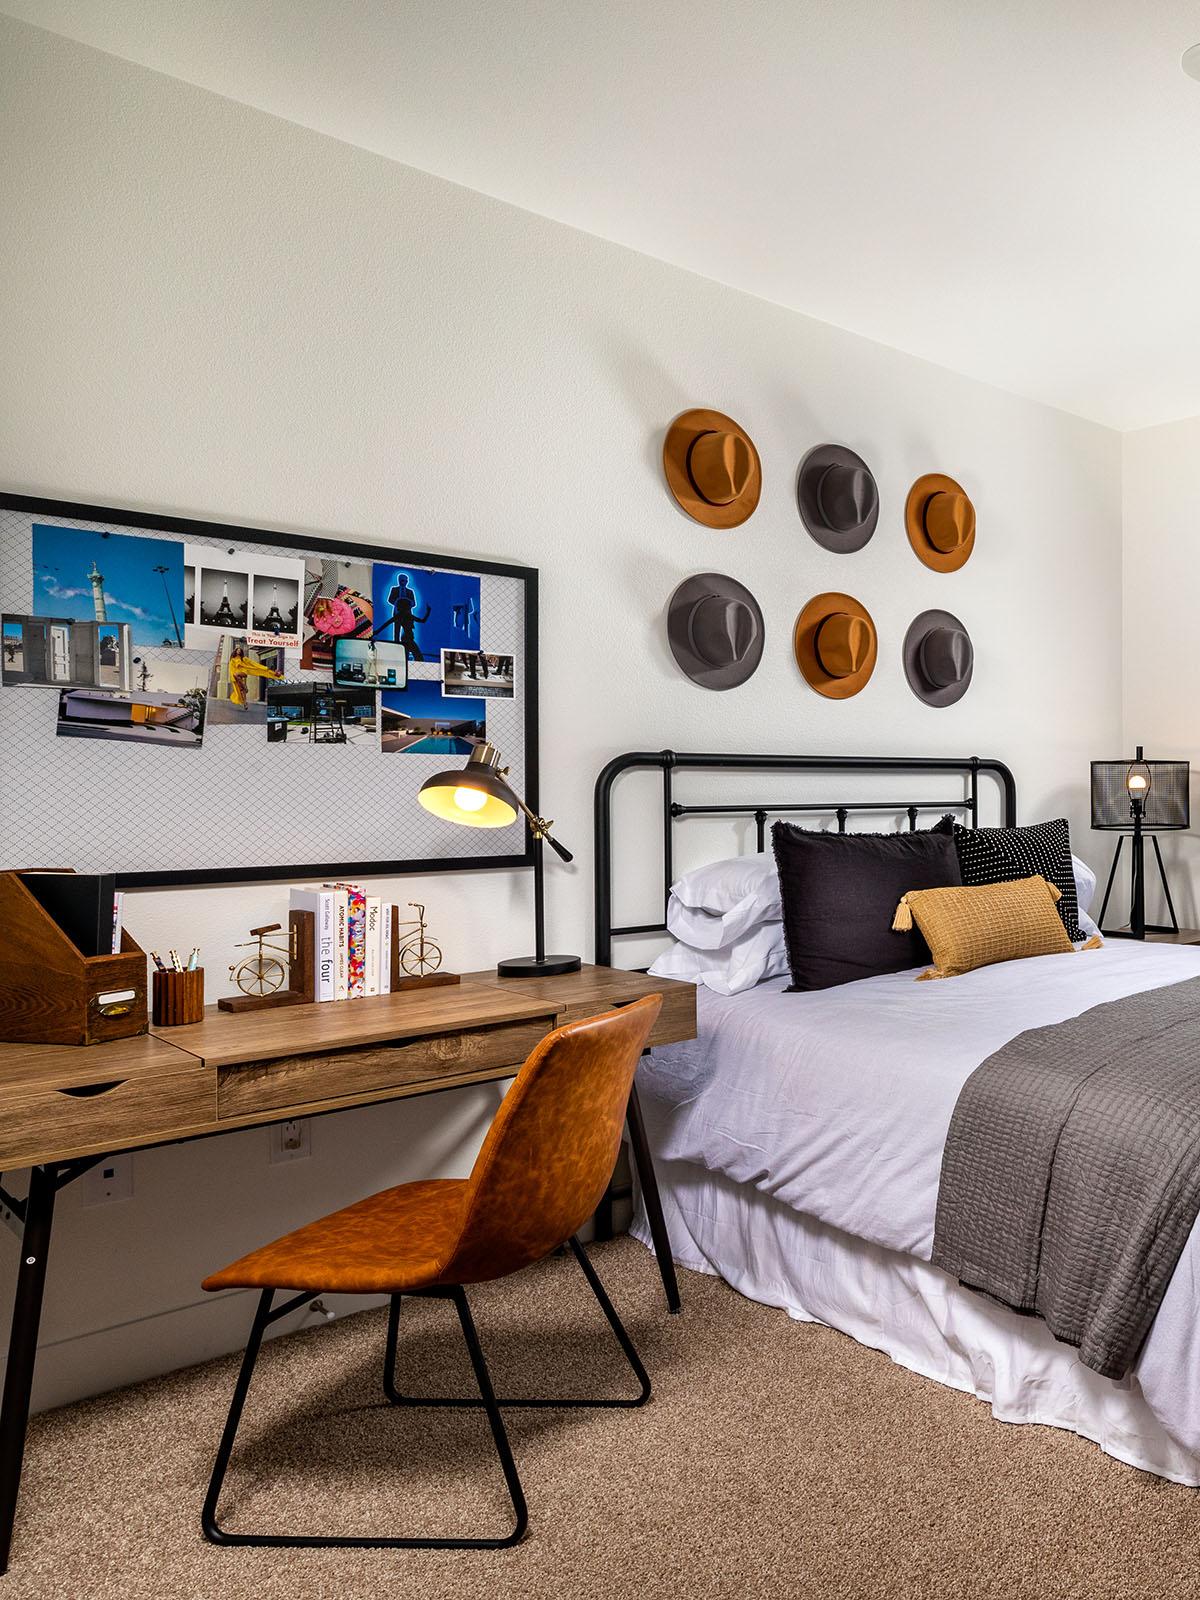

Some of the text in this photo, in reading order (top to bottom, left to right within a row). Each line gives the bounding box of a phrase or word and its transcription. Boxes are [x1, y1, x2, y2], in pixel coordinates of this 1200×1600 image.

[269, 639, 299, 647] Yourself
[369, 906, 378, 931] Modoc
[321, 937, 332, 955] the
[321, 959, 333, 983] four
